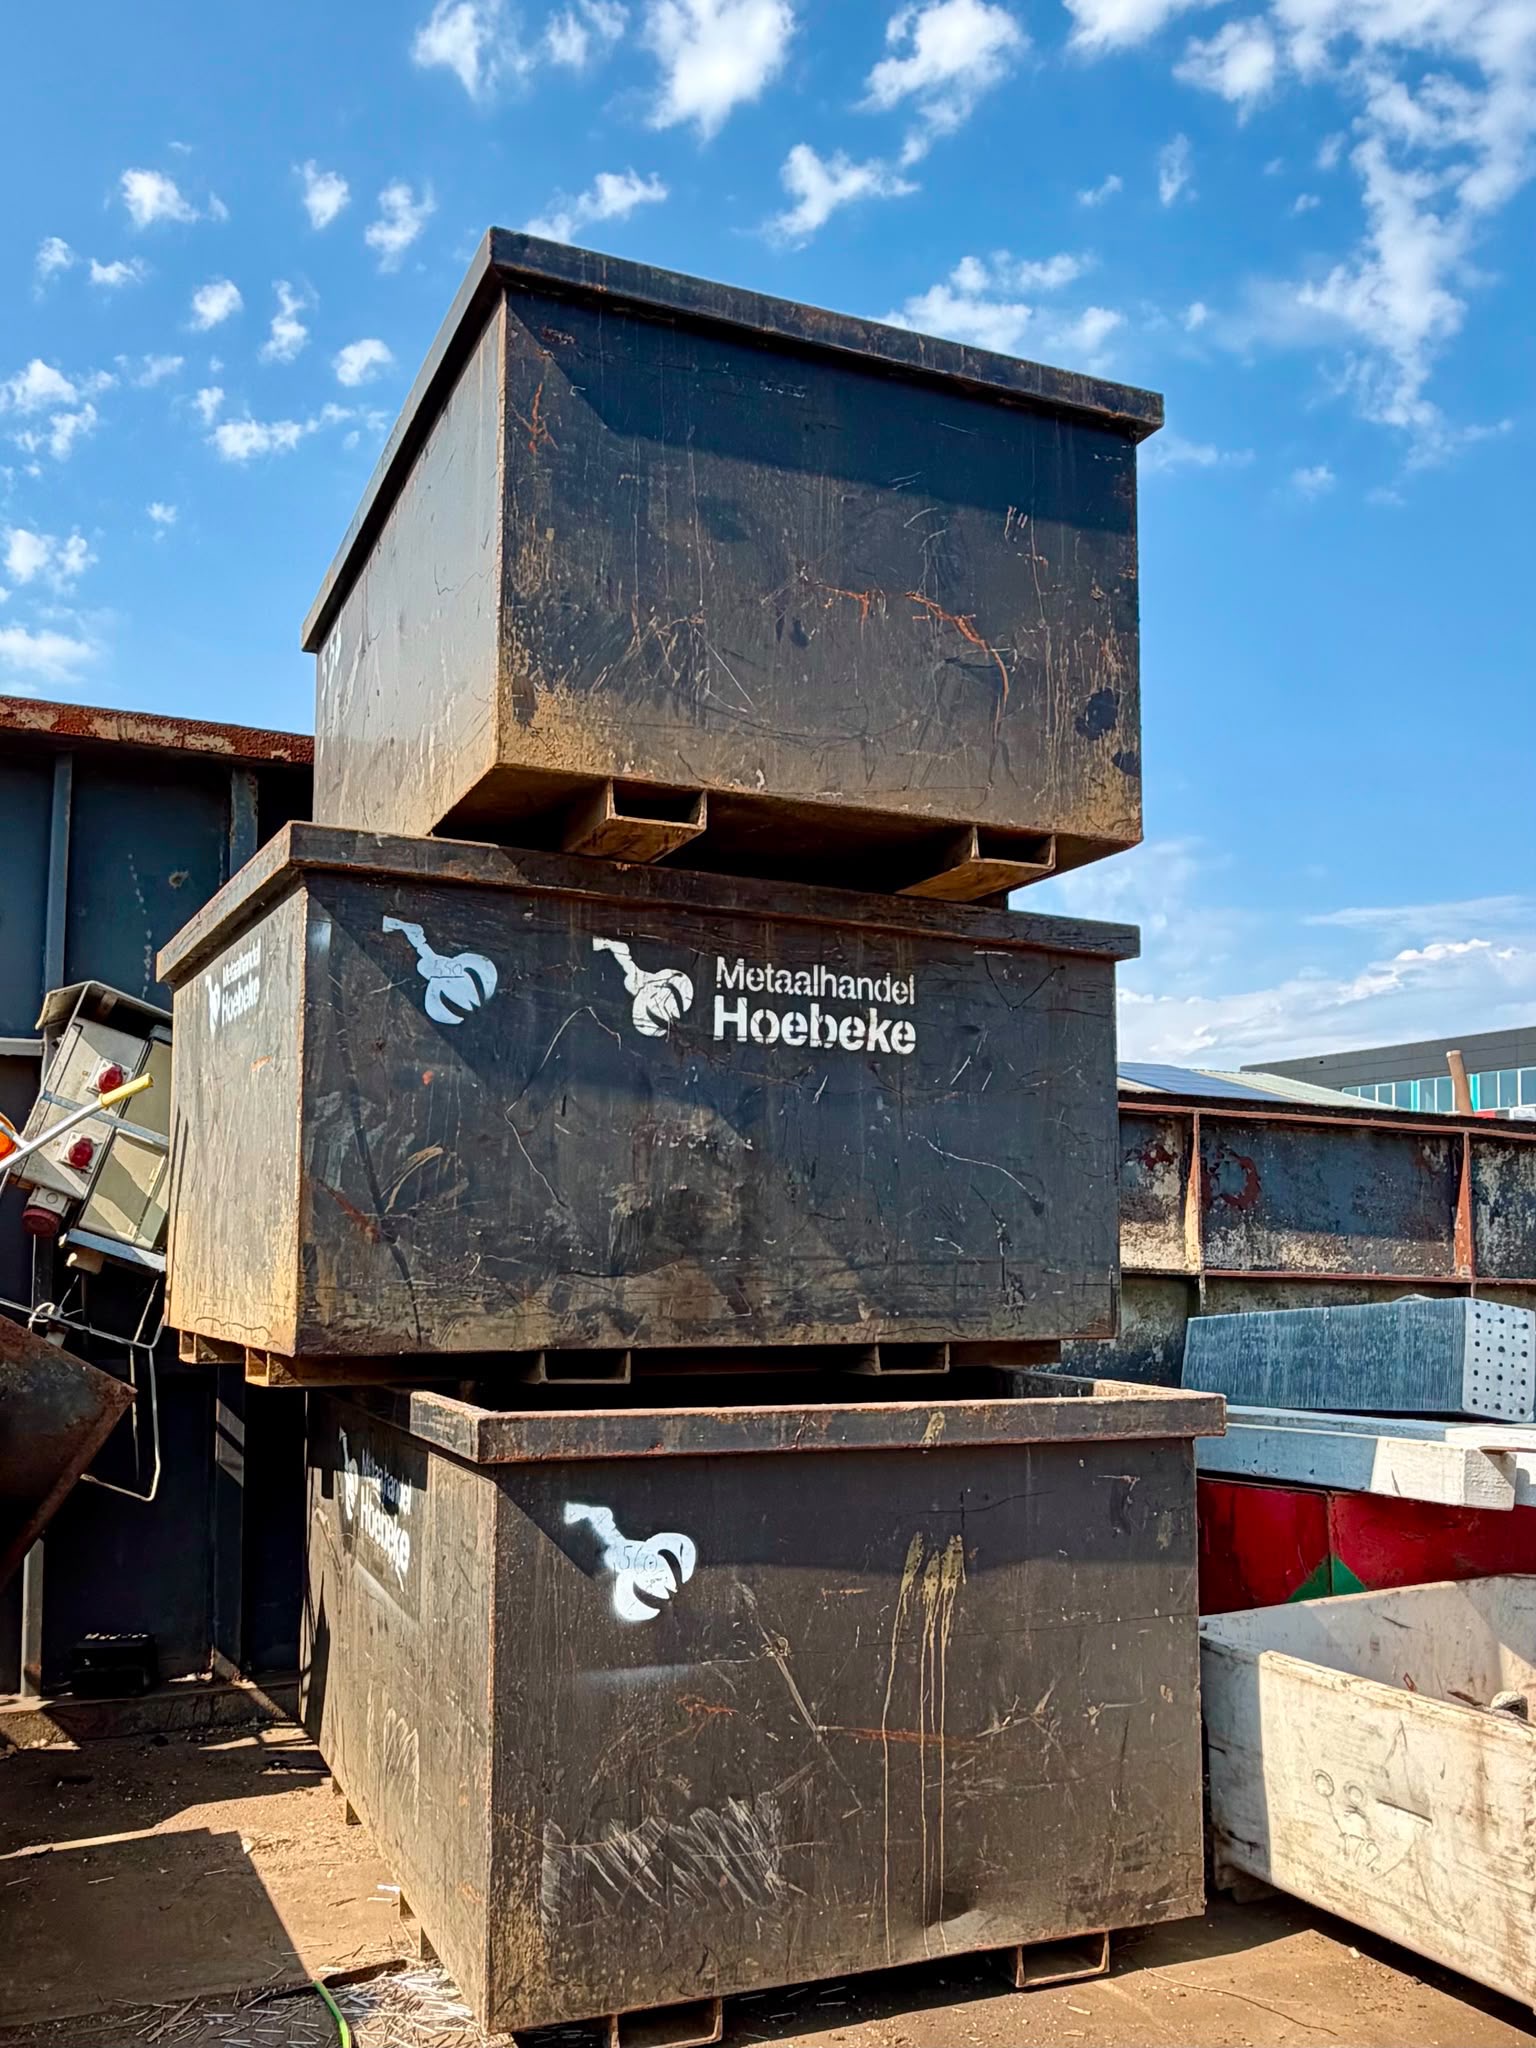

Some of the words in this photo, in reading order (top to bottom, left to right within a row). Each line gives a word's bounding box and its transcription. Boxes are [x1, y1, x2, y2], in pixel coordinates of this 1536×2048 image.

[221, 972, 260, 1028] Hoebeke
[715, 955, 915, 1006] Metaalhandel
[713, 995, 917, 1055] Hoebeke
